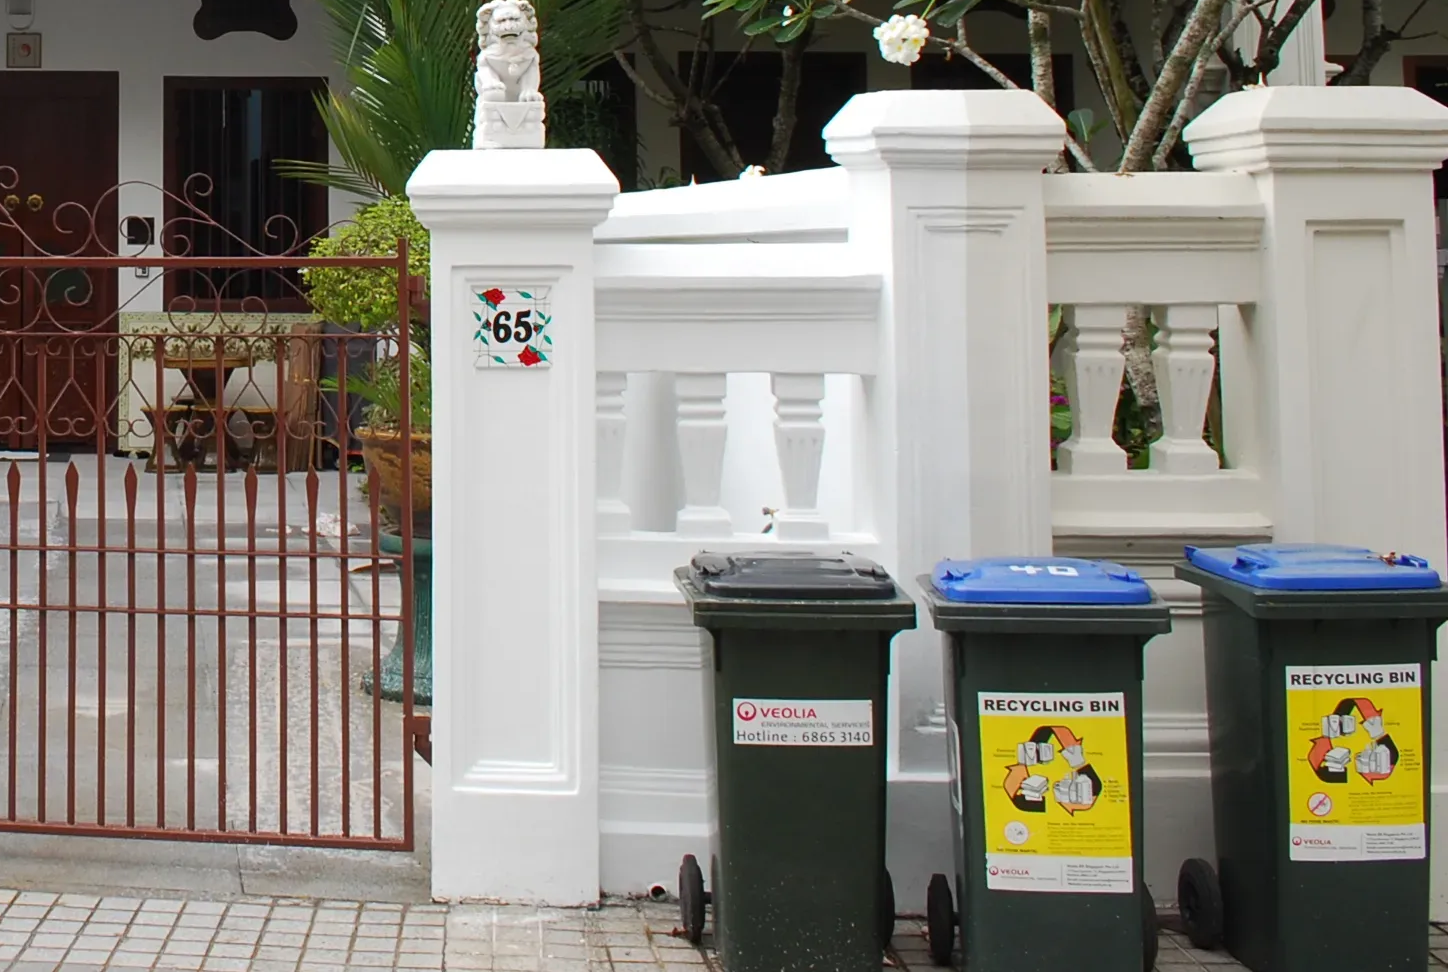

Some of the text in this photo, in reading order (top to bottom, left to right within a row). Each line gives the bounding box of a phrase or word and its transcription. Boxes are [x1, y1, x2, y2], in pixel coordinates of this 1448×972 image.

[492, 309, 533, 344] 65
[1291, 671, 1416, 686] RECYCLING BIN
[983, 699, 1120, 712] RECYCLING BIN
[760, 707, 817, 719] VEOLIA
[736, 730, 788, 742] Hotline
[802, 731, 836, 743] 6865
[840, 731, 871, 743] 3140
[1000, 868, 1030, 876] VEOLIA
